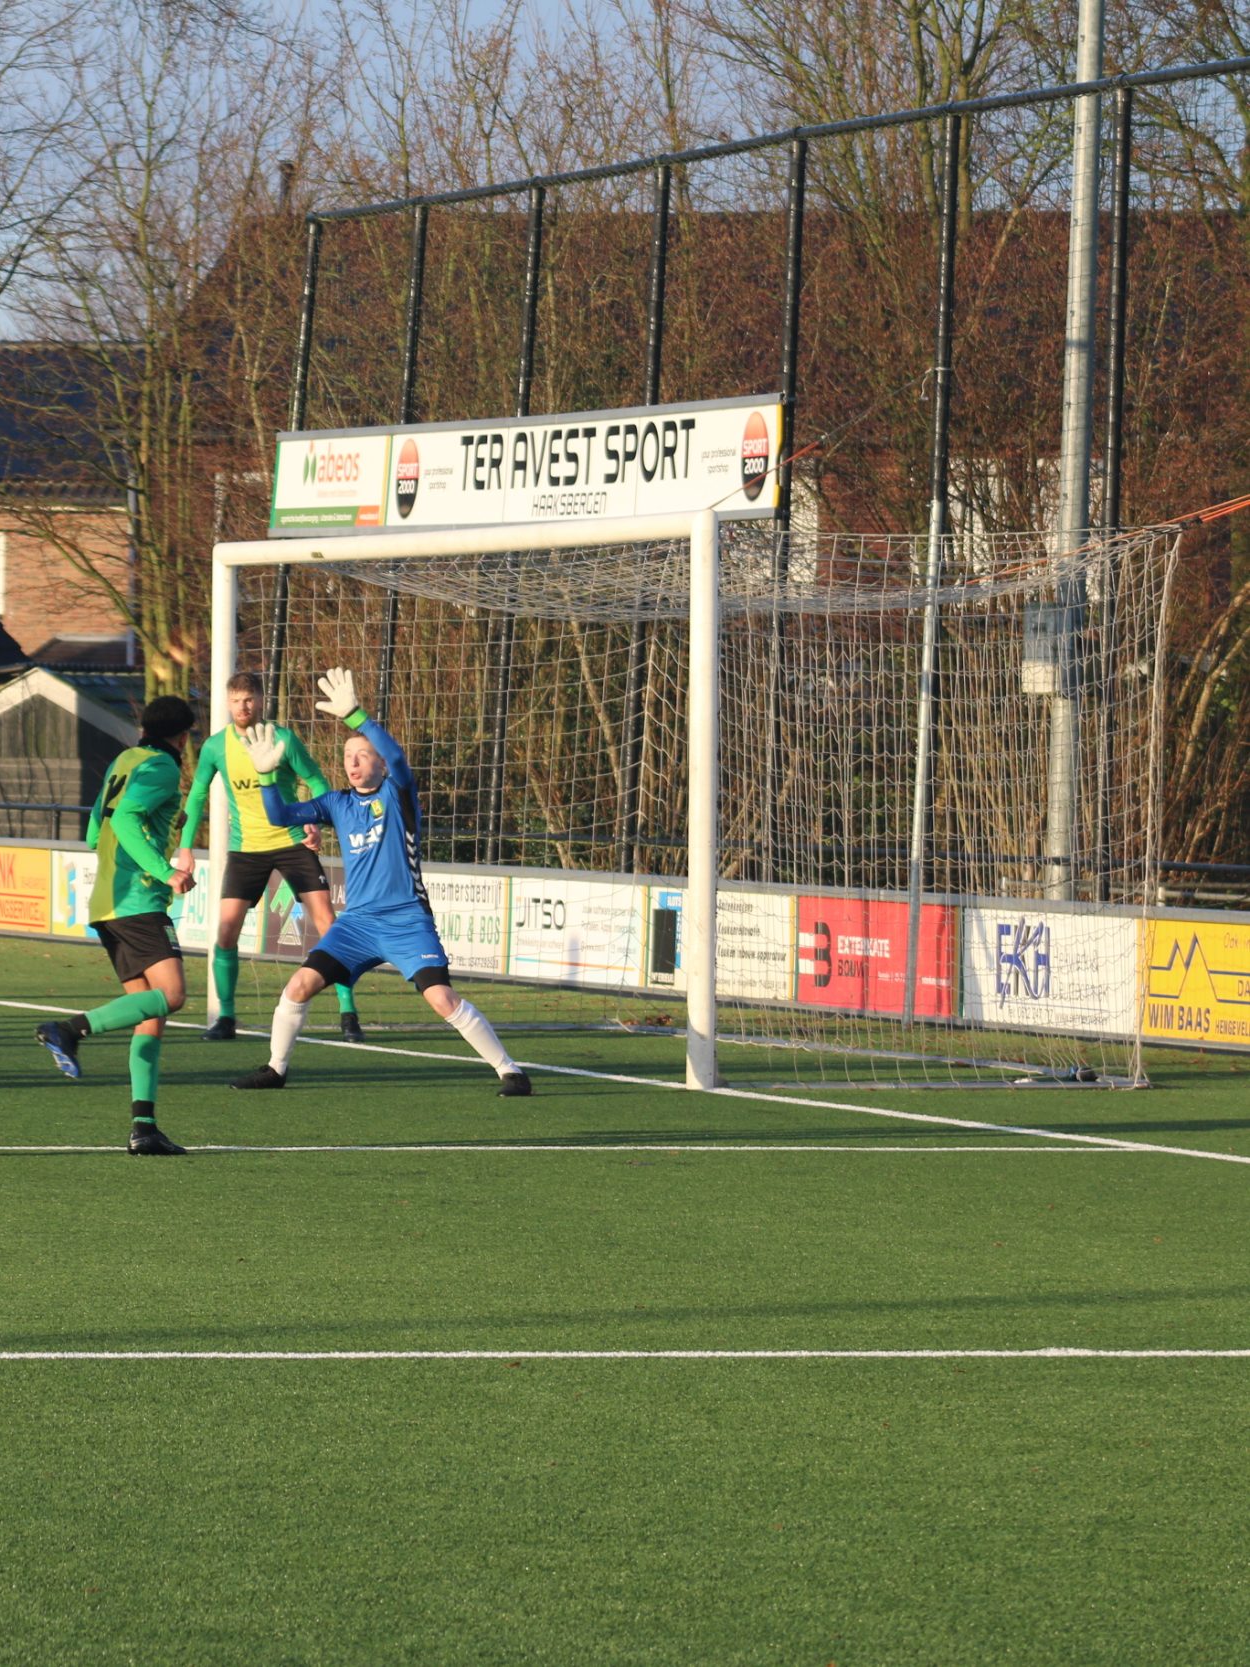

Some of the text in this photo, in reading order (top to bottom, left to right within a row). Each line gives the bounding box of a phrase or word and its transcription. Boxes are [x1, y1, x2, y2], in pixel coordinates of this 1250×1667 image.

[460, 419, 696, 491] TER AVEST SPORT
[742, 438, 769, 456] SPORT
[317, 443, 360, 484] abeos
[397, 462, 420, 479] SPORT
[744, 457, 766, 475] 2000
[398, 479, 415, 495] 2000
[531, 491, 607, 517] HAAKSBERGEN
[515, 896, 566, 930] JITSO
[480, 915, 501, 945] BOS
[837, 935, 890, 958] EXTERKATE
[837, 959, 865, 979] BOUW
[1149, 1003, 1174, 1030] WIM
[1178, 1005, 1211, 1034] BAAS
